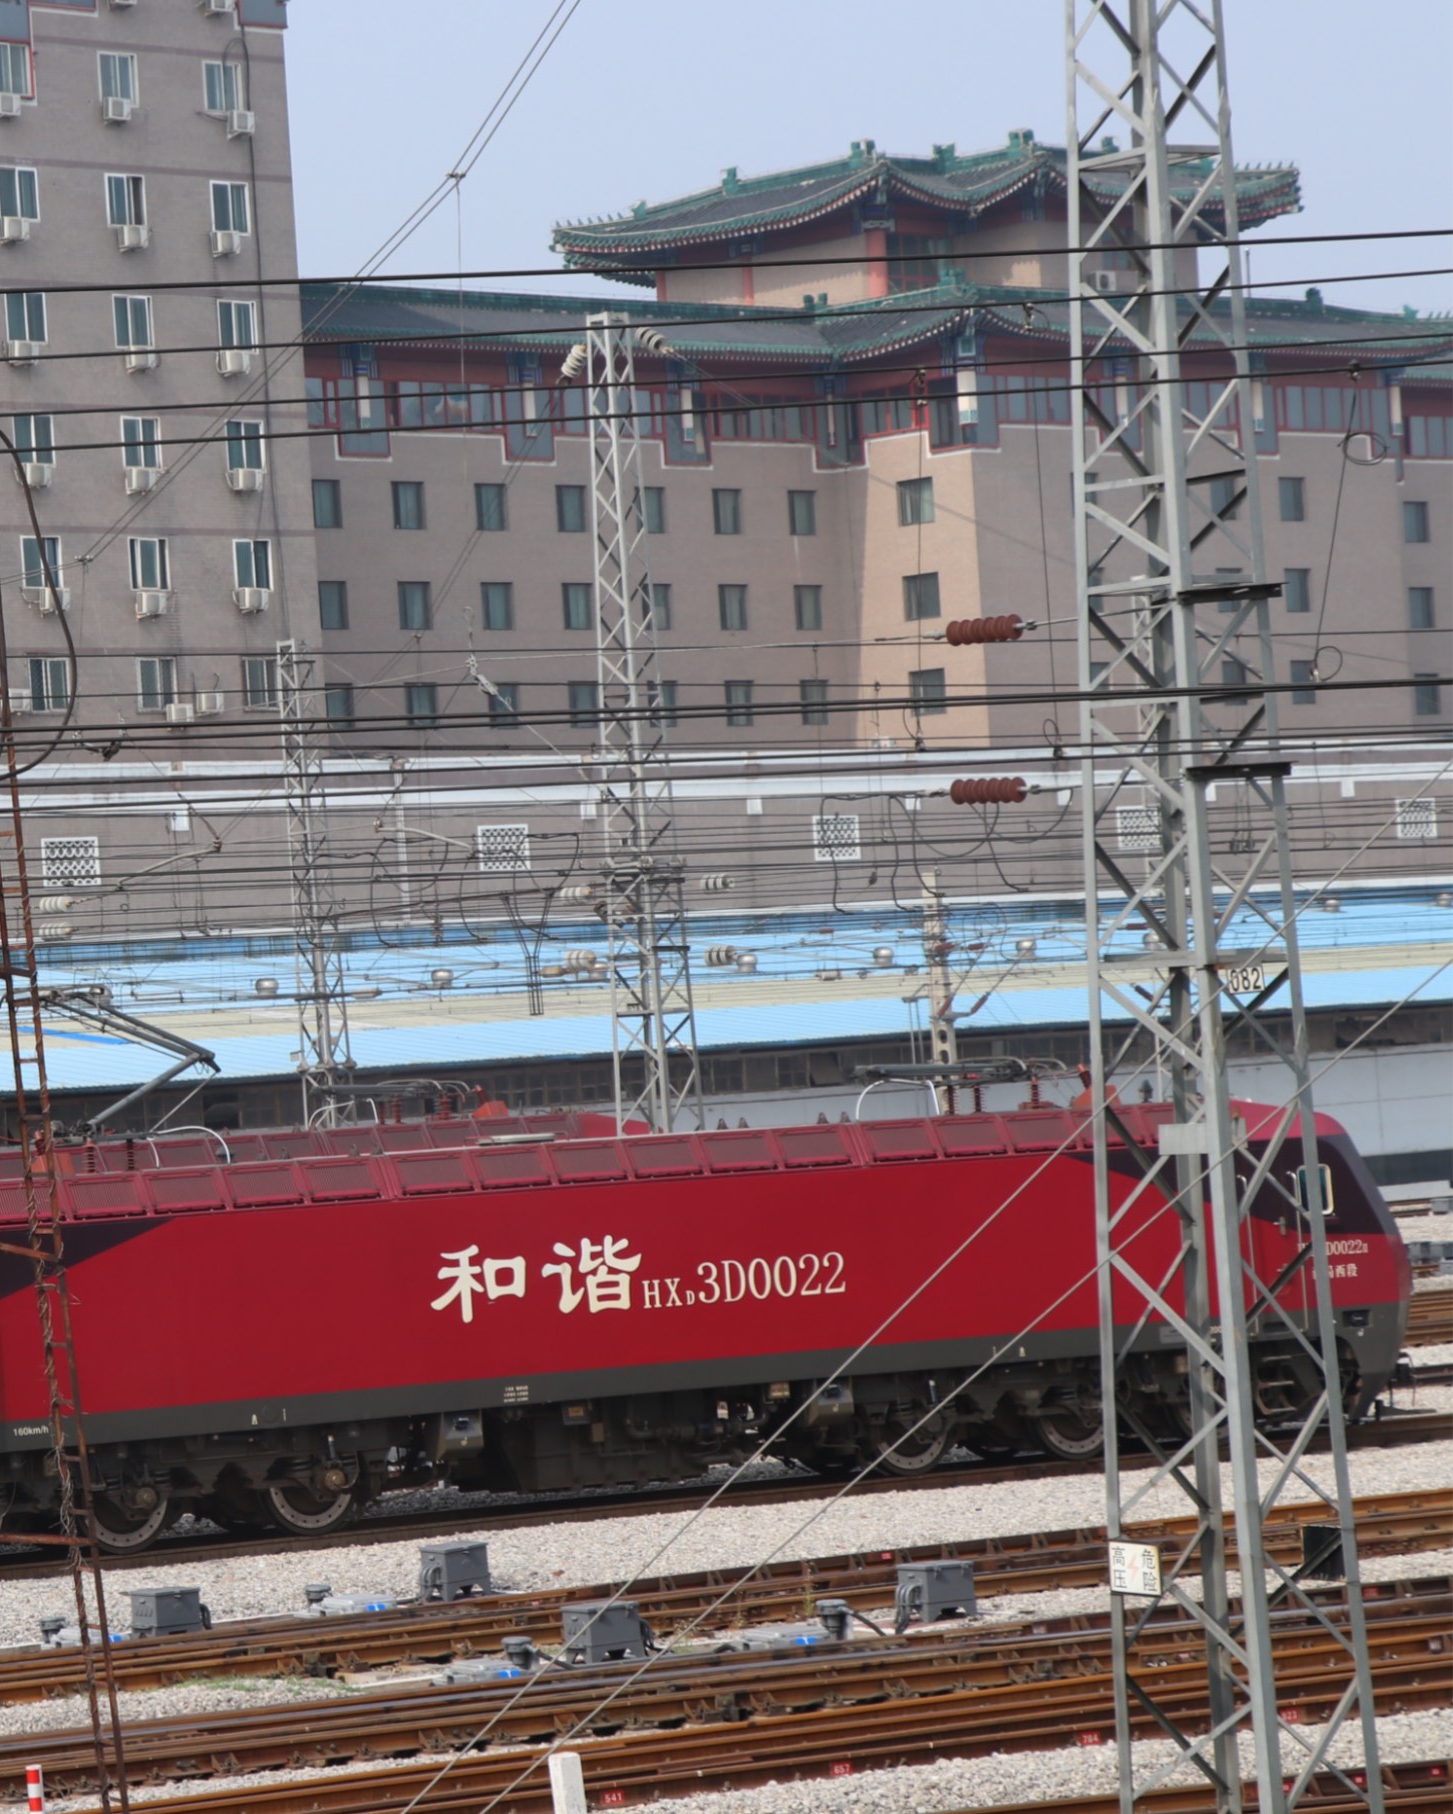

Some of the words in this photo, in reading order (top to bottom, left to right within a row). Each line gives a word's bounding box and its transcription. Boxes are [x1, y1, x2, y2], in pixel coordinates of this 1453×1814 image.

[1229, 967, 1262, 992] 082
[430, 1235, 642, 1323] 和谐
[642, 1251, 846, 1309] HXD3D0022
[12, 1425, 49, 1437] 160km/h
[1111, 1546, 1127, 1590] 高压
[1140, 1548, 1159, 1592] 危险
[603, 1791, 623, 1804] 541
